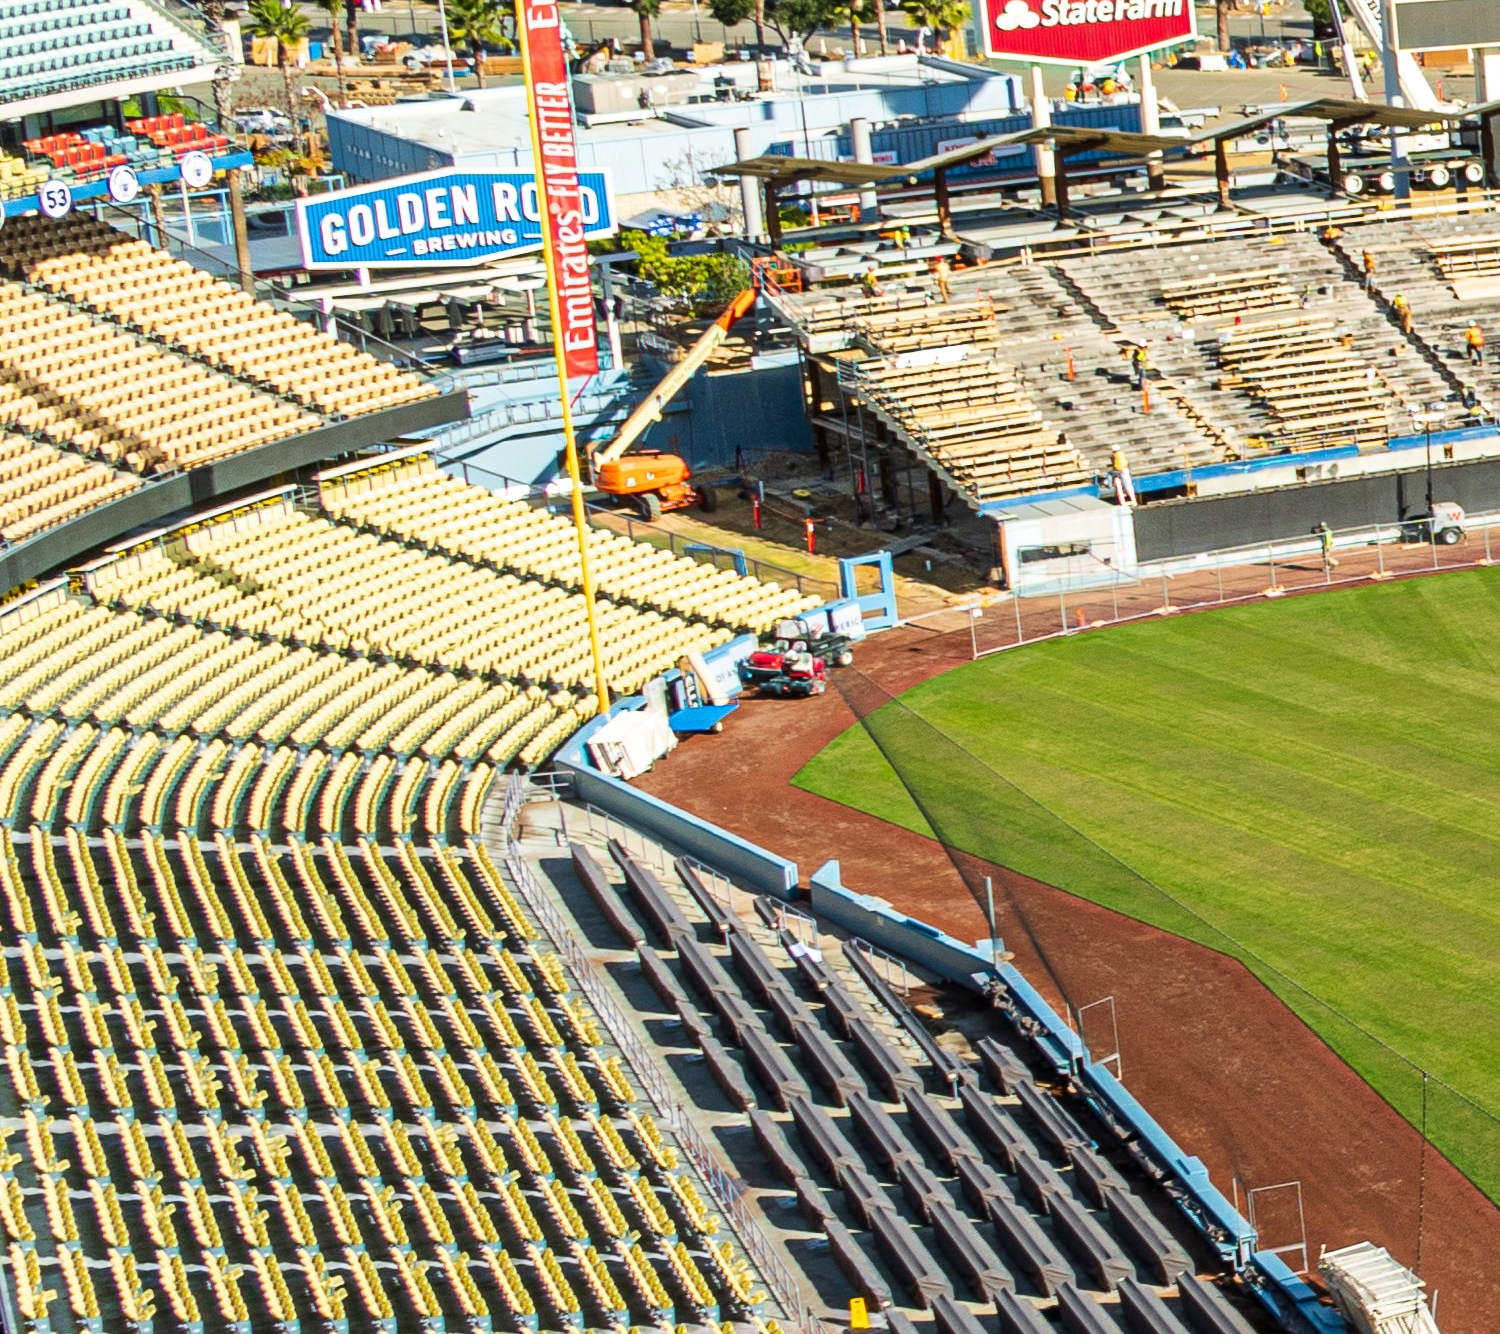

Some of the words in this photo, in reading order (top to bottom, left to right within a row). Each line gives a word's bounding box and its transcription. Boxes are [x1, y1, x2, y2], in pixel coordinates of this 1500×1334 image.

[536, 81, 576, 158] BETTER
[46, 188, 67, 209] 53
[545, 164, 579, 198] FLY
[320, 183, 480, 256] GOLDEN
[493, 182, 599, 225] ROD
[413, 229, 518, 256] BREWING
[557, 208, 595, 354] Emirates
